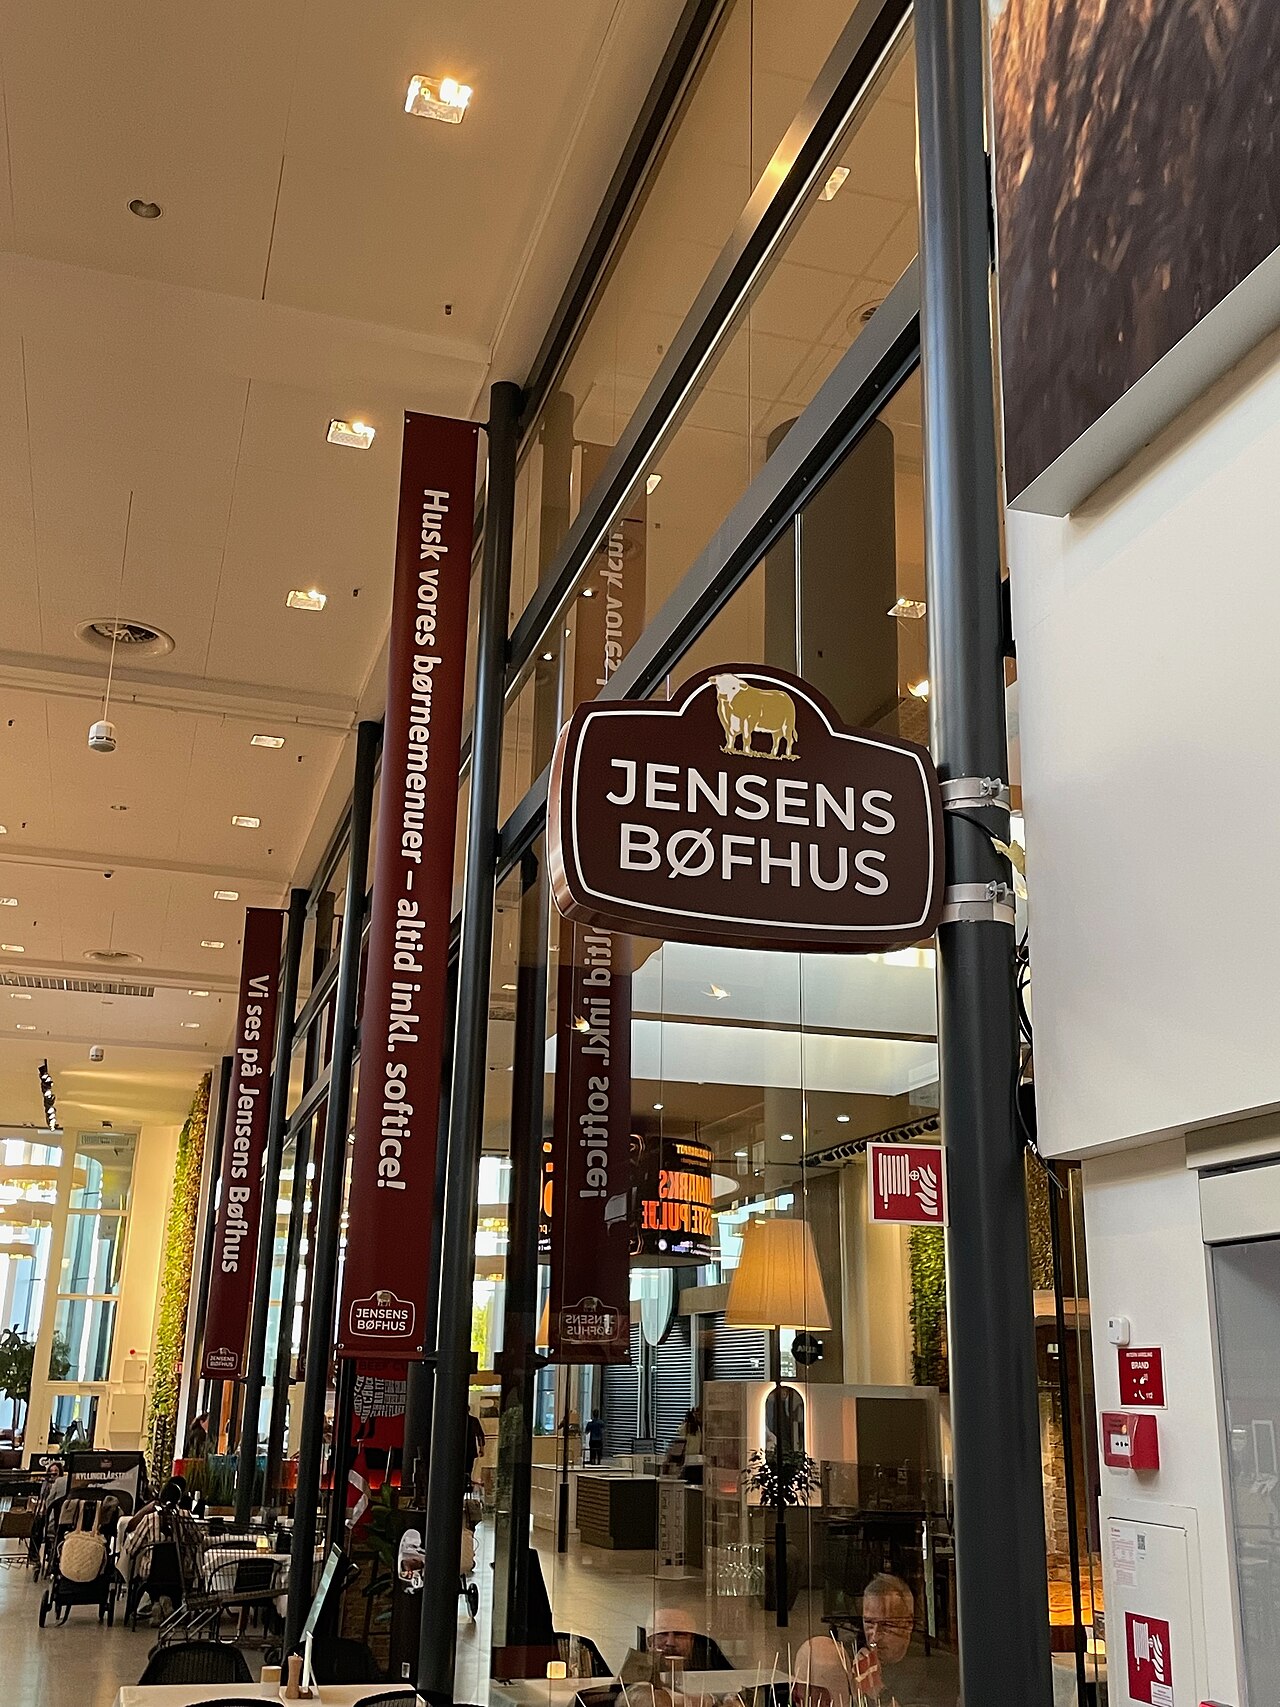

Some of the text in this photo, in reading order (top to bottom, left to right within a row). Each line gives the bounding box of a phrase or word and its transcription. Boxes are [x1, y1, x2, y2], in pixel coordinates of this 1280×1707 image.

[420, 489, 449, 561] Husk
[415, 568, 438, 647] vores
[401, 654, 442, 864] børnemenuer
[606, 758, 896, 835] JENSENS
[619, 822, 889, 896] BØFHUS
[393, 898, 425, 973] altid
[387, 982, 420, 1052] inkl.
[221, 975, 270, 1274] Vi ses på Jensens Bøfhus
[377, 1062, 411, 1190] softice!
[355, 1308, 408, 1320] JENSENS
[357, 1319, 406, 1331] BØFHUS
